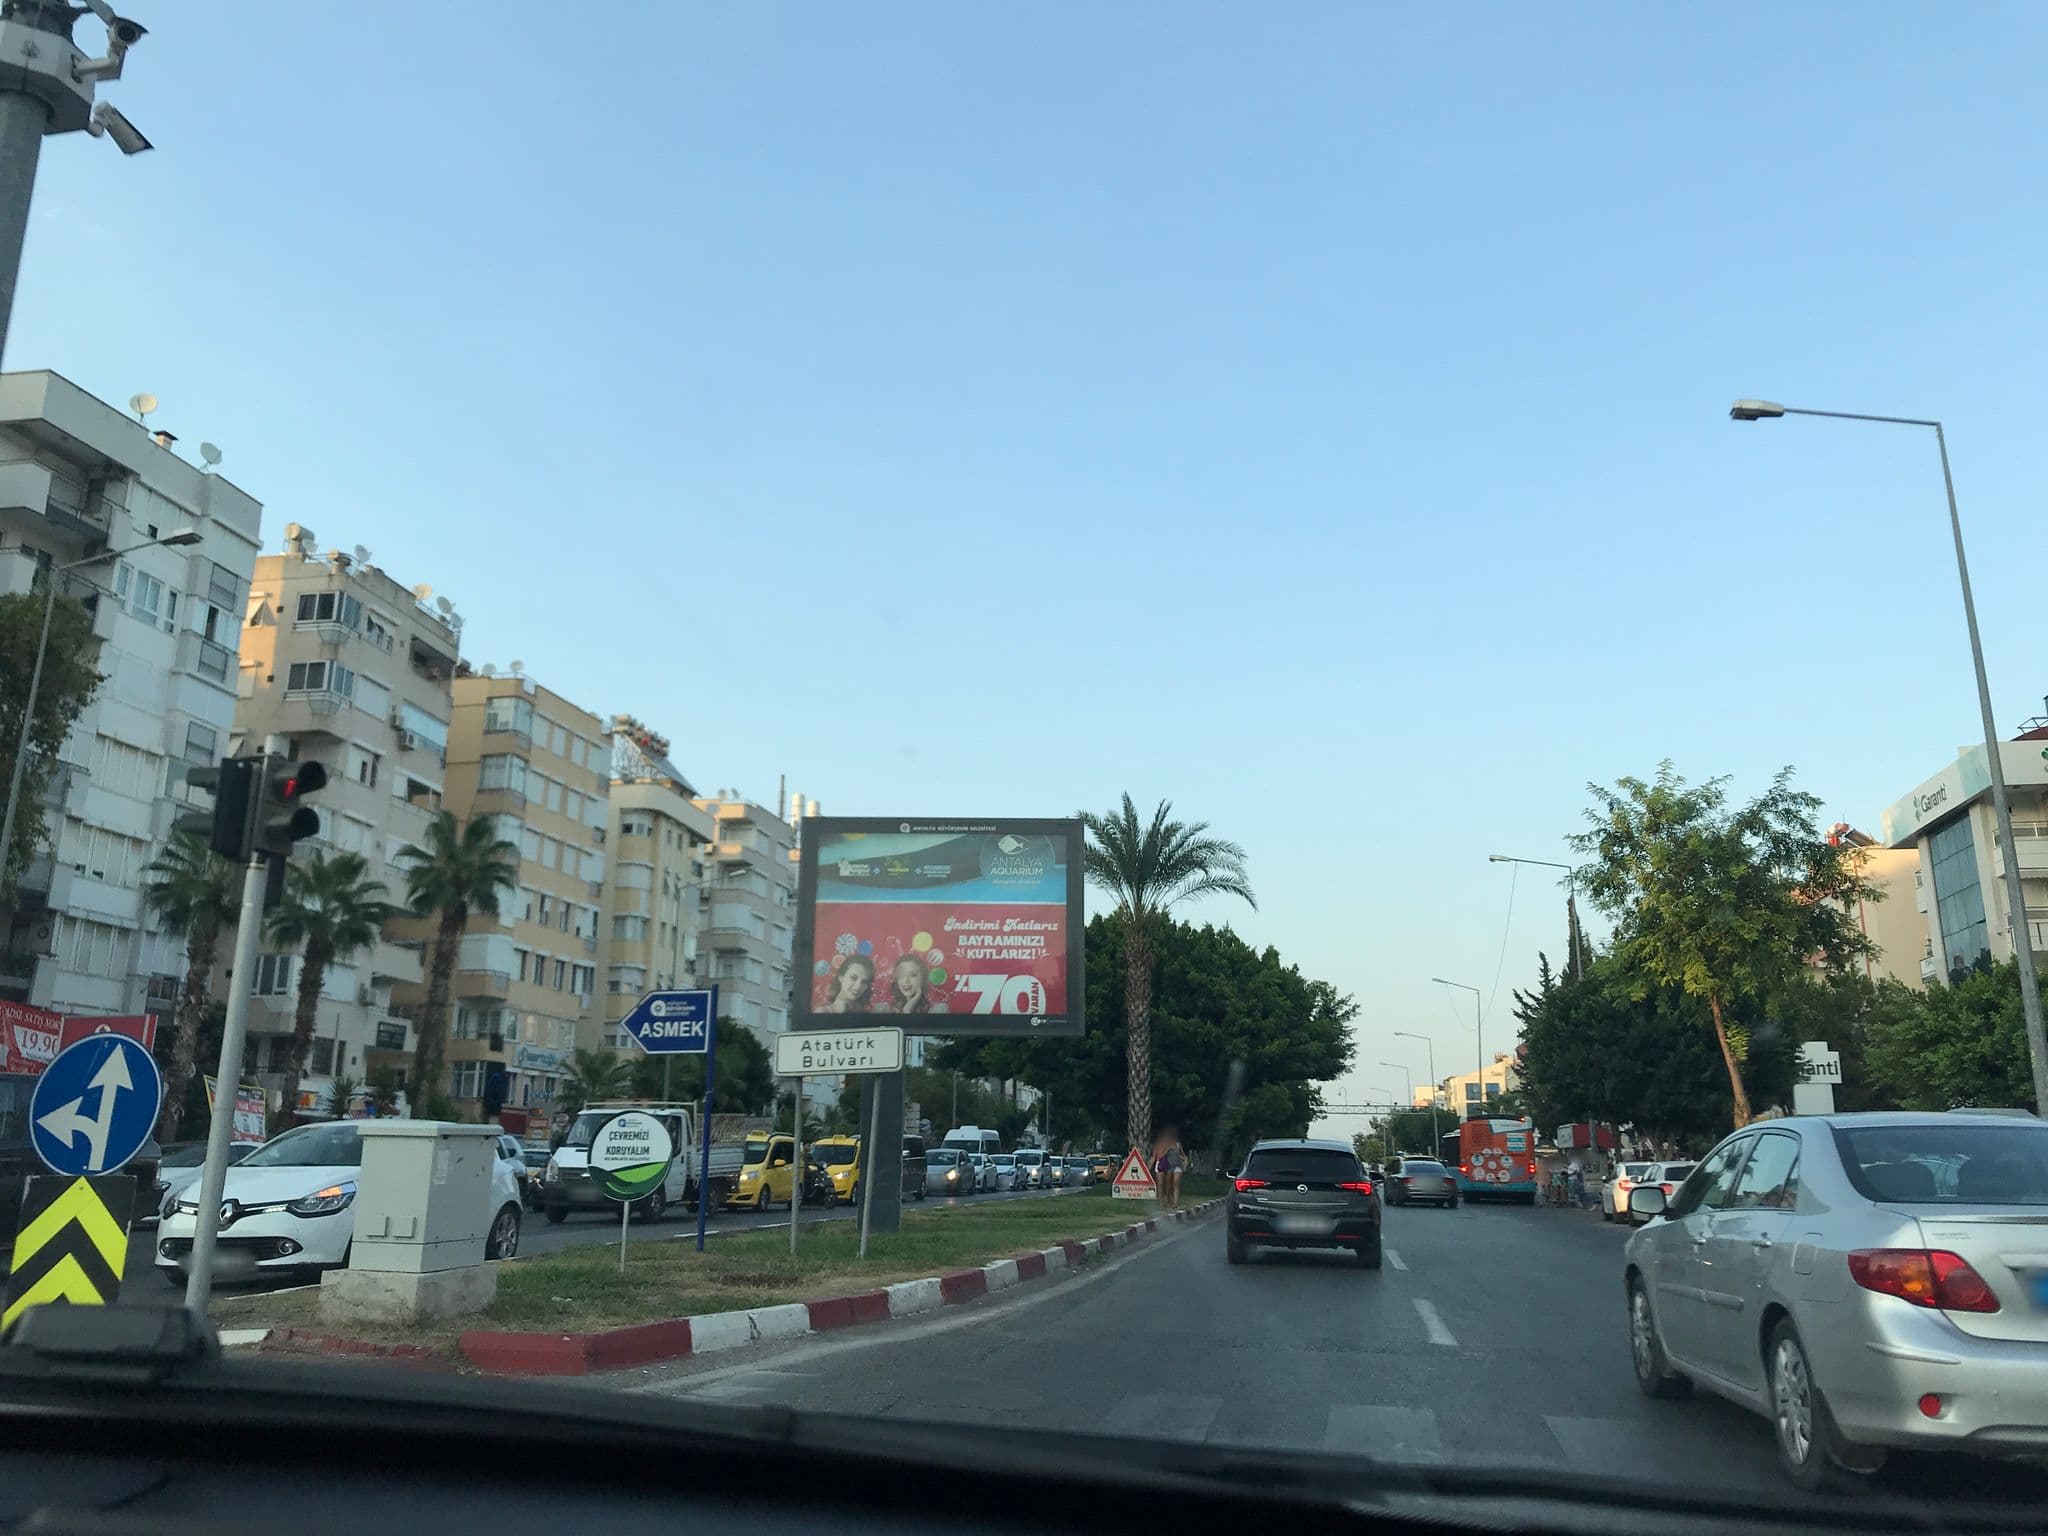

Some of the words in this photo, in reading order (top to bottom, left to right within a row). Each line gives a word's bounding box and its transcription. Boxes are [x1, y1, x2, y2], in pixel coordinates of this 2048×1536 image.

[1920, 783, 1947, 813] Garanti
[990, 857, 1043, 868] ANTALYA
[989, 867, 1043, 876] AQUARIUM
[958, 935, 1045, 947] BAYRAMINIZI
[1031, 982, 1040, 1014] VARAN
[638, 1021, 704, 1038] ASMEK
[800, 1036, 875, 1052] Atatürk
[802, 1055, 873, 1068] Bulvarı
[608, 1128, 650, 1142] ÇEVREMİZİ
[605, 1145, 650, 1156] KORUYALIM
